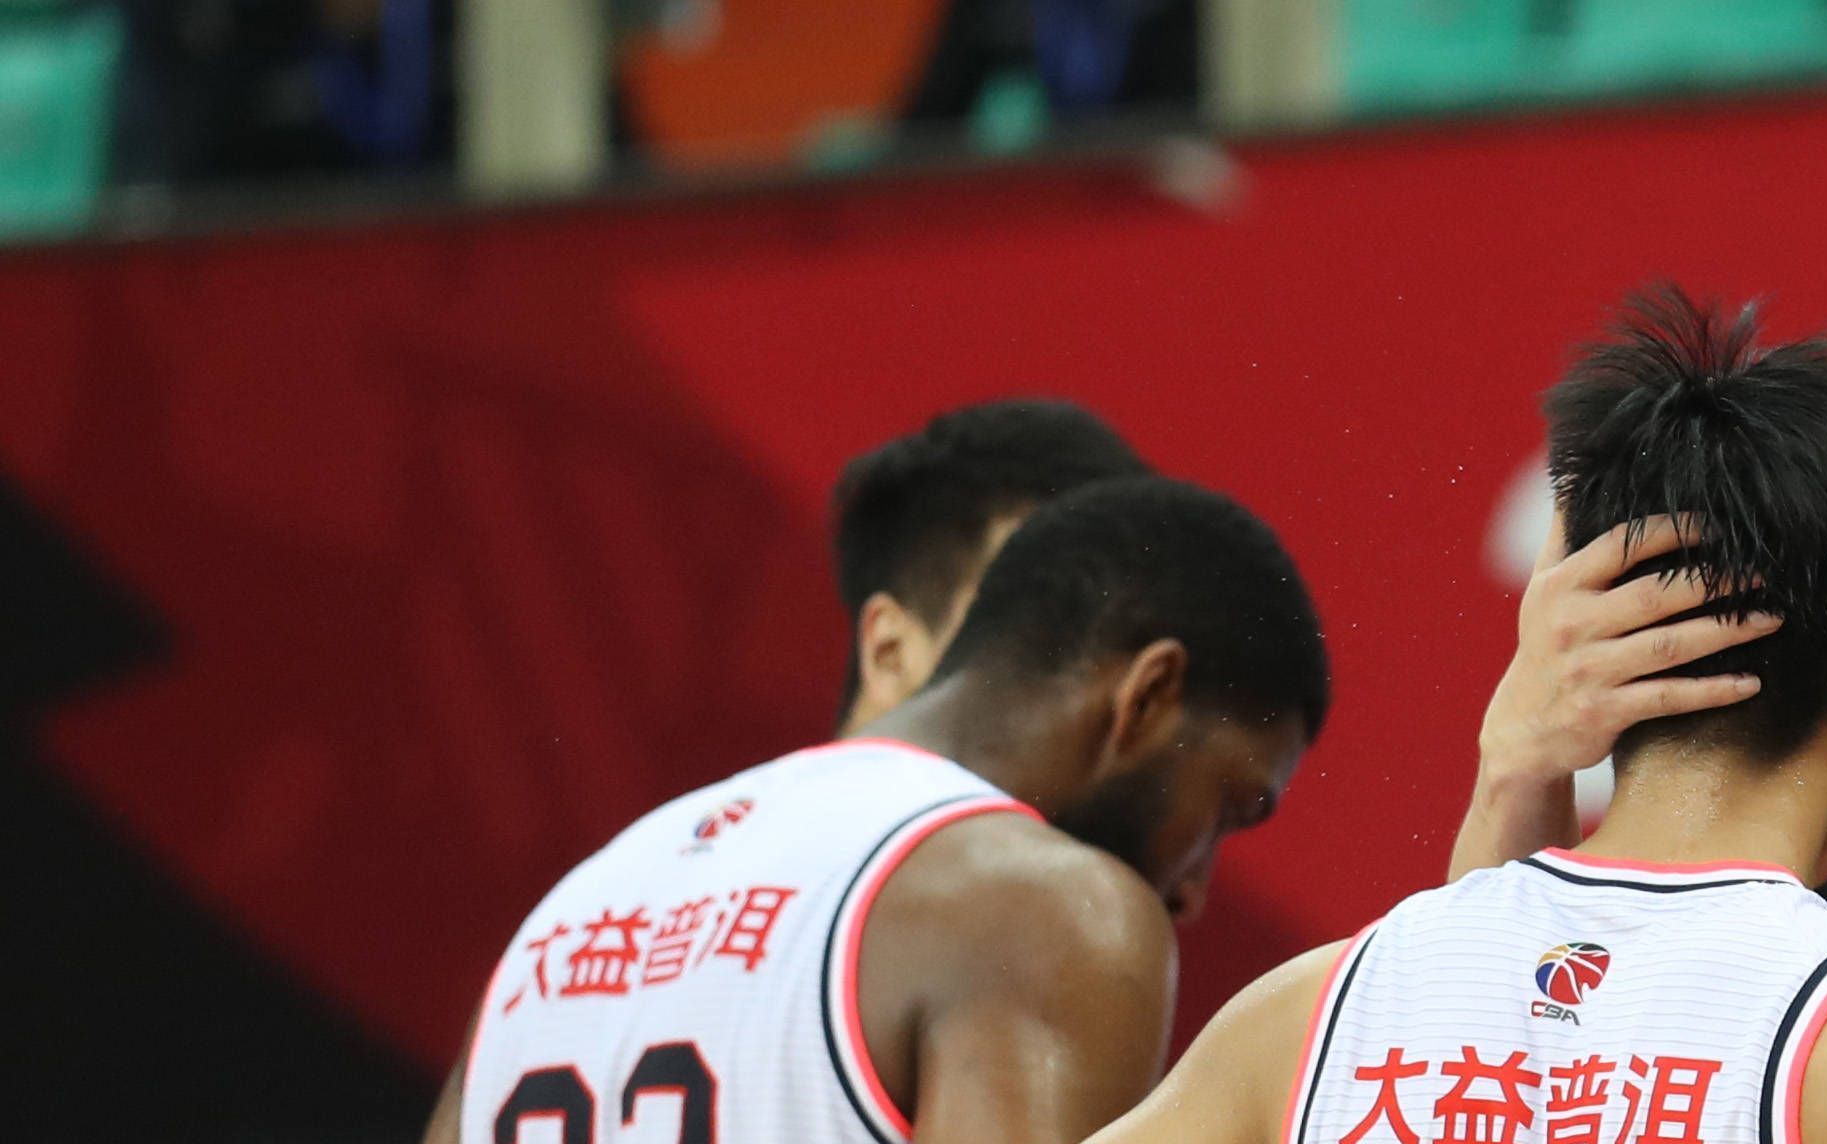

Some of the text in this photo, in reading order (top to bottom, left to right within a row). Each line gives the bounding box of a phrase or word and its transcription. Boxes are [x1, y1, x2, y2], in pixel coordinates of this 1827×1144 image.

[501, 886, 799, 1015] 大益普洱
[1531, 1000, 1581, 1027] CBA
